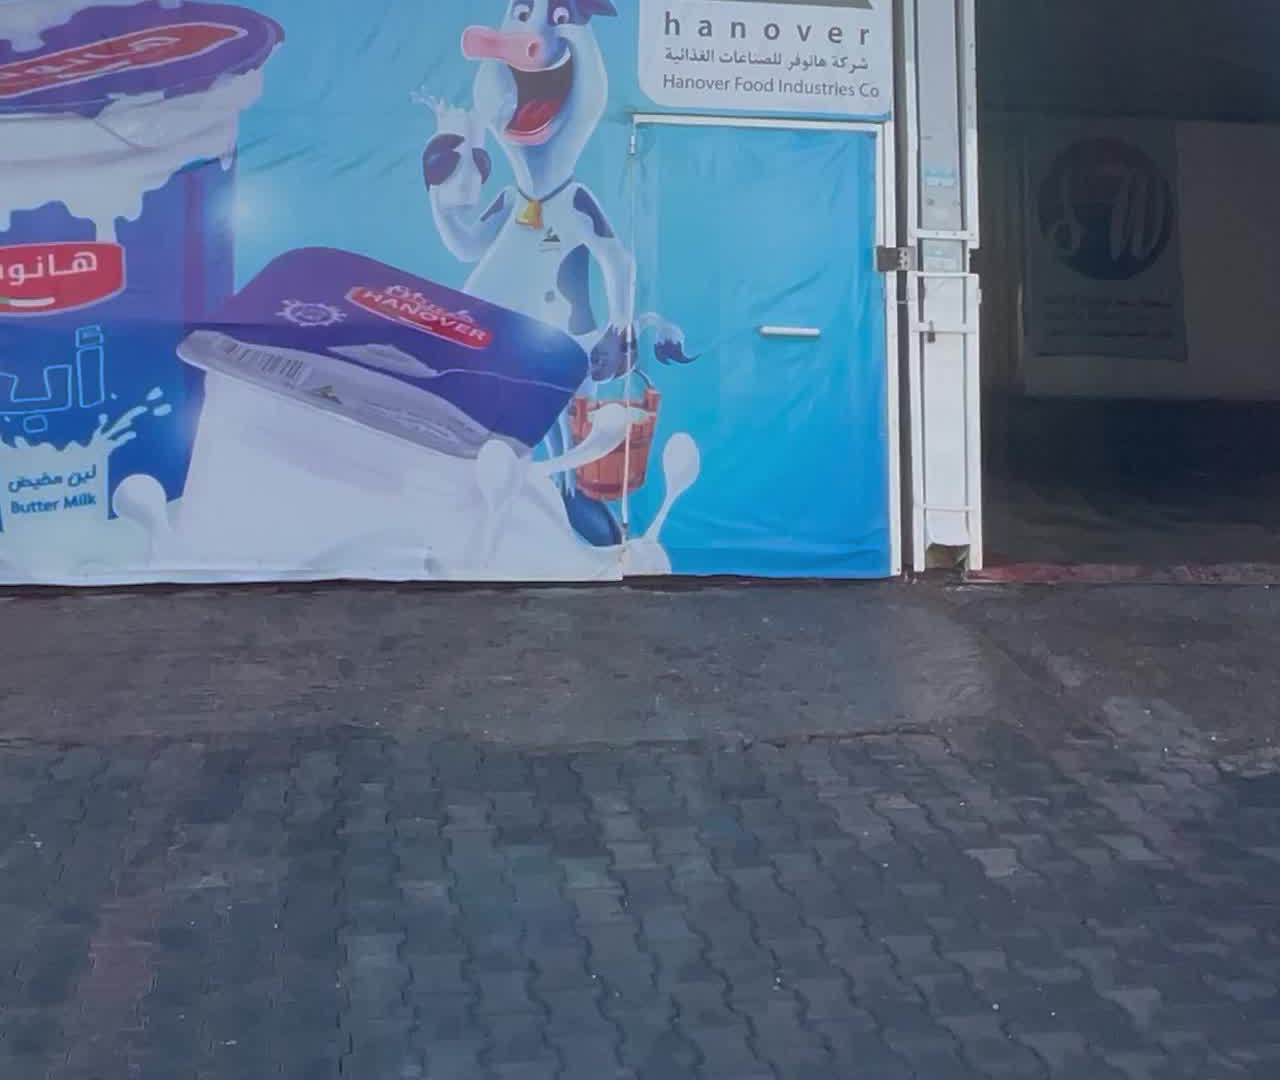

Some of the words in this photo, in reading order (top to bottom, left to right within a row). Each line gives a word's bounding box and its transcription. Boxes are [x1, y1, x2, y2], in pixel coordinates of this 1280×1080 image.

[664, 11, 870, 45] hanover
[665, 47, 715, 64] الغذائية
[719, 50, 782, 66] للصناعات
[832, 56, 869, 74] شركة
[663, 74, 731, 91] Hanover
[735, 77, 774, 93] Food
[779, 79, 855, 97] Industries
[859, 83, 880, 98] Co
[363, 291, 487, 340] HANOVER
[68, 464, 96, 487] لبن
[11, 500, 59, 514] Butter
[63, 493, 96, 509] Milk
